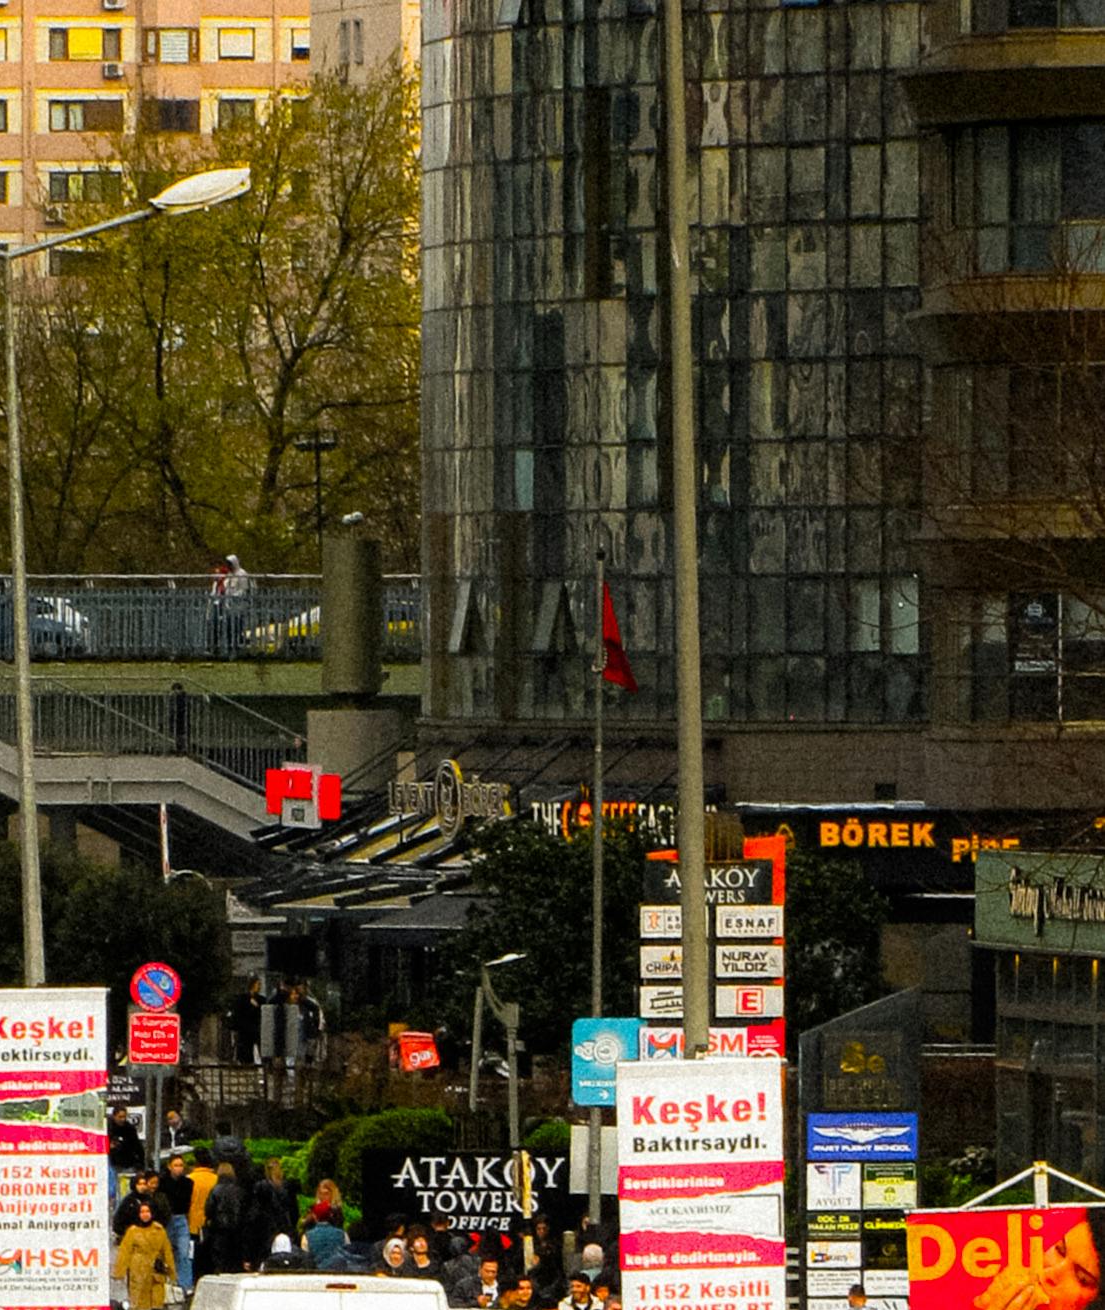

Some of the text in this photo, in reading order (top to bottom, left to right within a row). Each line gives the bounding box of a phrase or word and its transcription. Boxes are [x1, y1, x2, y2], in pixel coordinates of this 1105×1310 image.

[820, 818, 935, 848] BÖREK
[664, 864, 760, 887] AKÖY
[676, 889, 745, 904] WERS
[725, 917, 775, 928] ESNAF
[722, 951, 768, 961] NURAY
[722, 962, 768, 972] YILDIZ
[631, 1092, 767, 1132] Keşke!
[632, 1134, 767, 1154] Baktırsaydı.
[40, 1165, 96, 1179] Kesitli
[77, 1182, 98, 1196] BT
[623, 1177, 725, 1190] Sevdiklerinize
[416, 1191, 539, 1214] TOWERS
[27, 1219, 101, 1232] Anjiyografi
[906, 1213, 1044, 1282] Deli
[25, 1248, 99, 1268] HSM
[625, 1253, 668, 1267] keşke
[636, 1280, 770, 1300] 1152 Kesitli
